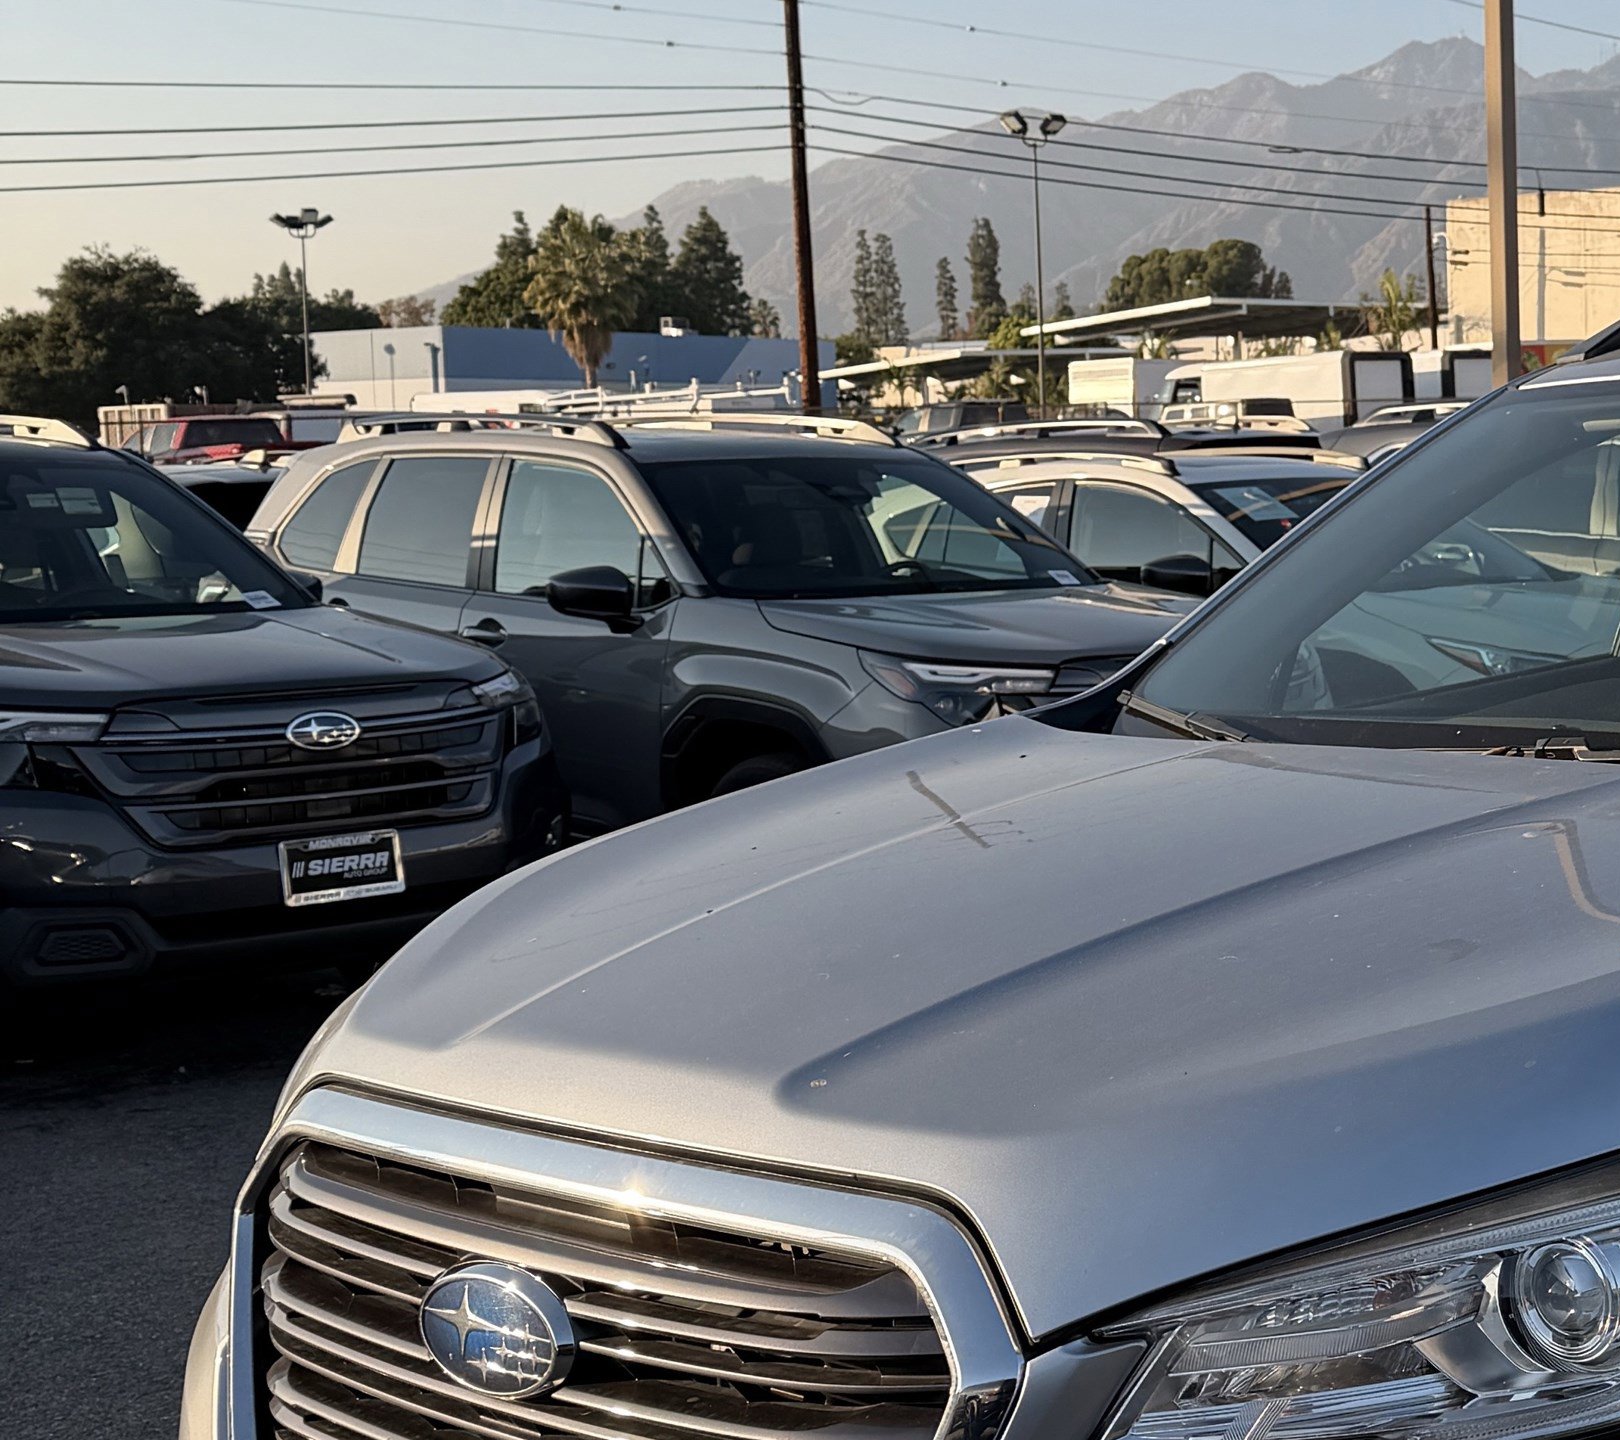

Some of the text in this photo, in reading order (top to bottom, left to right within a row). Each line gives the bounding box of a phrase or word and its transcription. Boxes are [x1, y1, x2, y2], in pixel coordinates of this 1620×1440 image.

[308, 835, 372, 850] MONROVIA
[307, 851, 390, 876] SIERRA
[343, 867, 388, 879] AUTO GROUP
[304, 890, 341, 902] SIERRA
